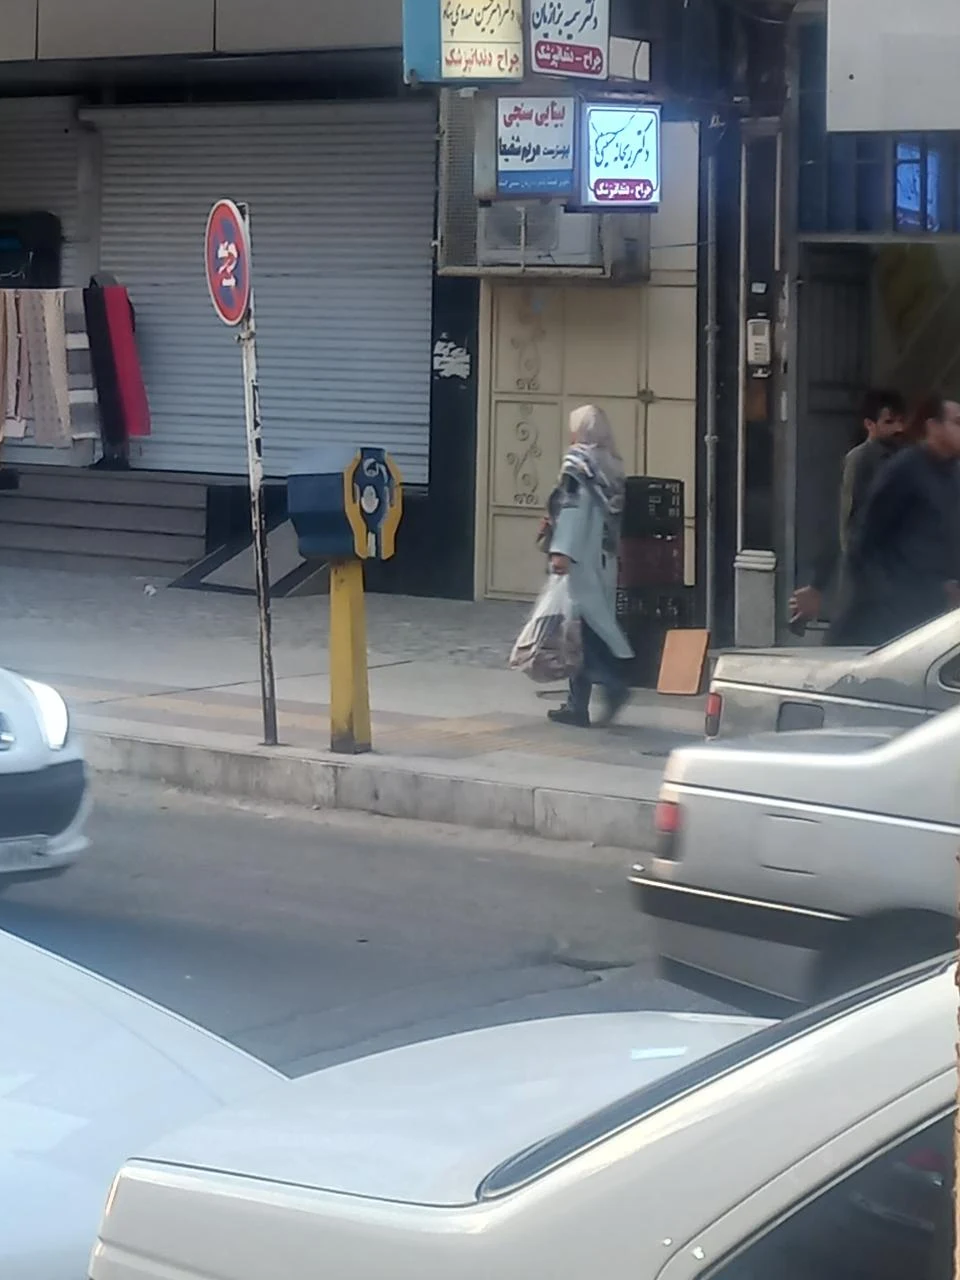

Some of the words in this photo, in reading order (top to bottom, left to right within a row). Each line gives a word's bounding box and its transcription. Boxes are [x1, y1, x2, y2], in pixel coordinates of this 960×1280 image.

[497, 49, 520, 73] جراح
[583, 51, 602, 71] جراح
[503, 103, 533, 128] سنجی
[631, 119, 653, 168] دکتر
